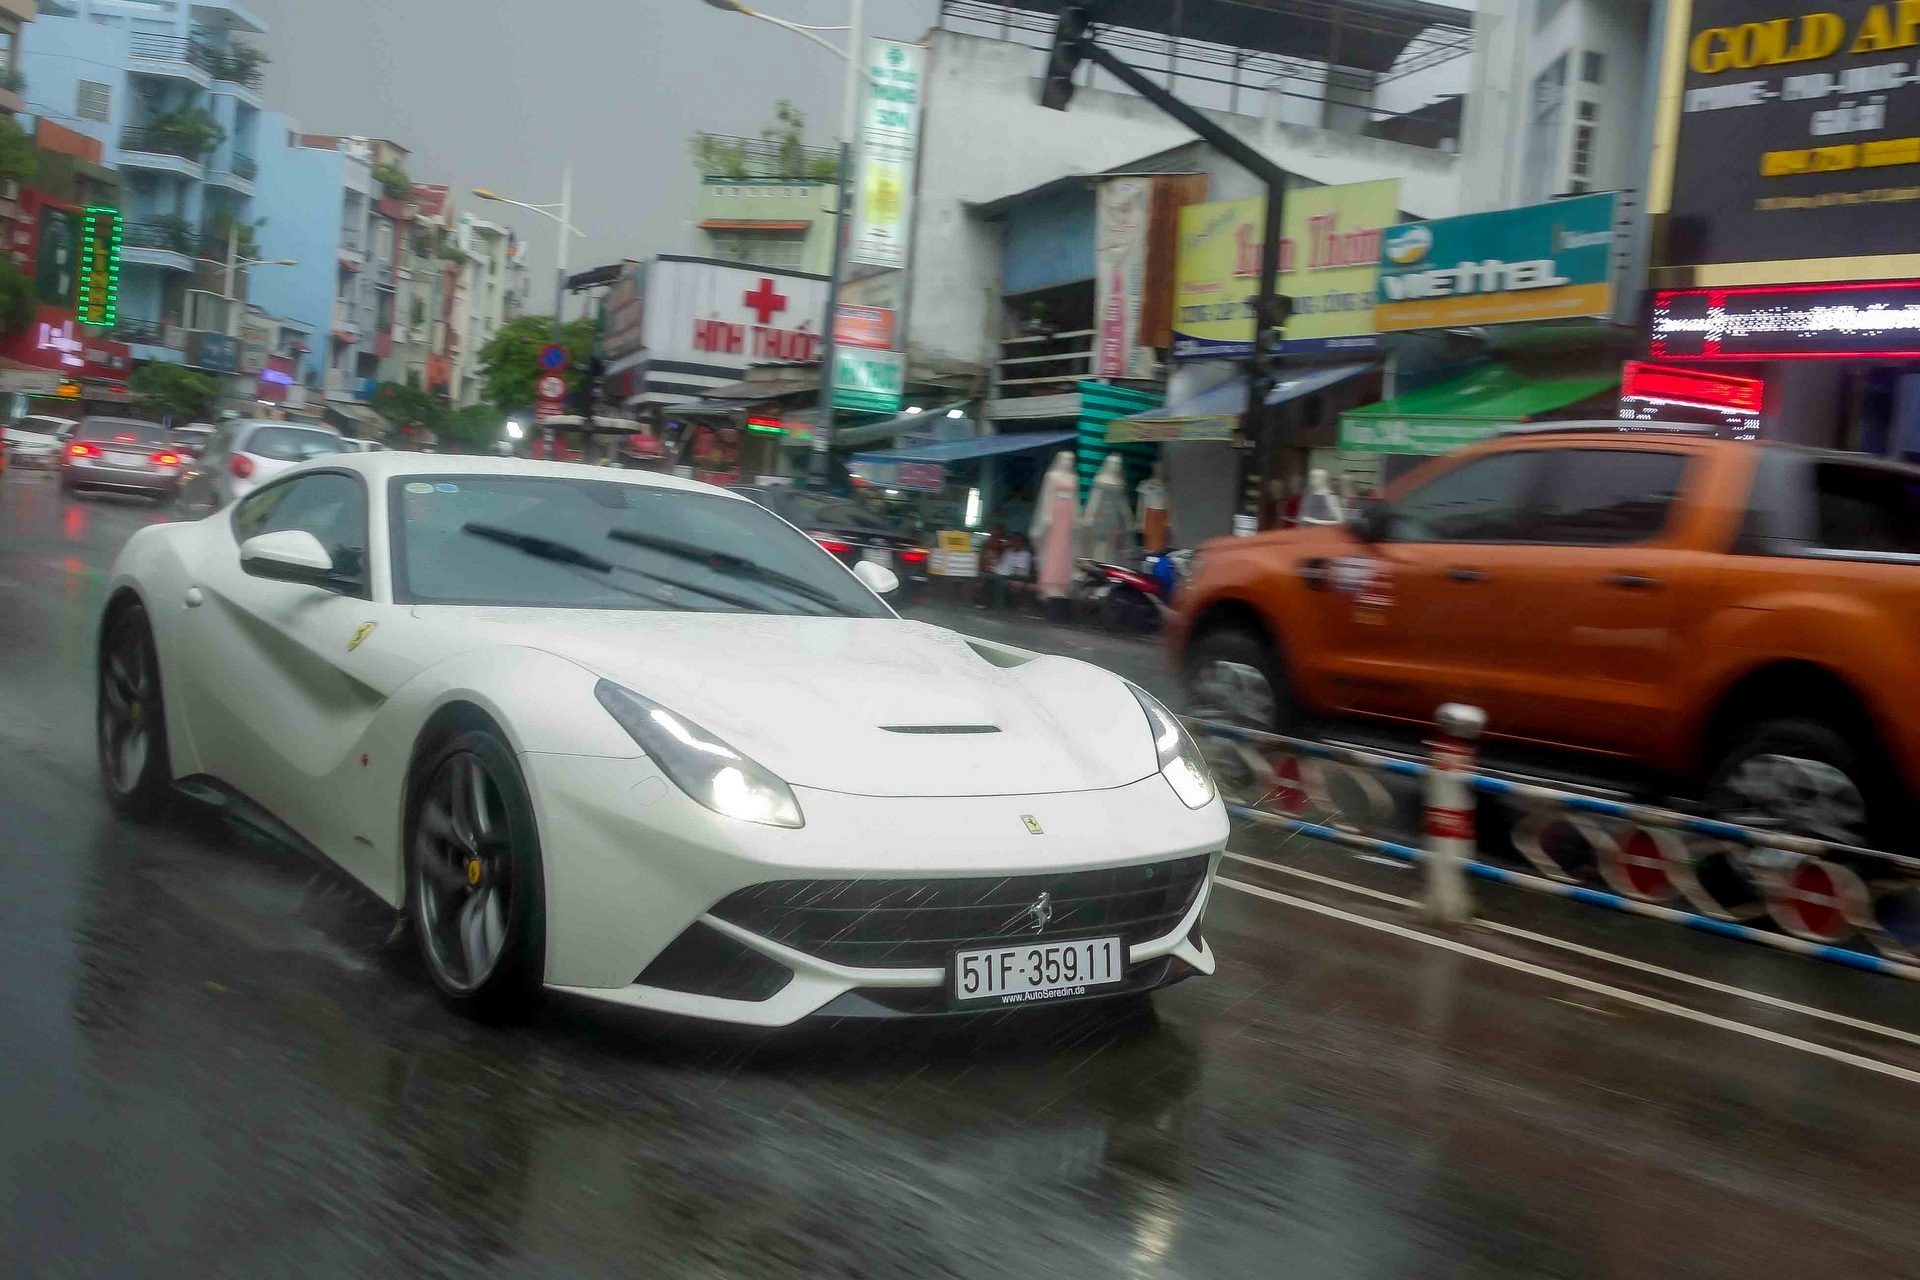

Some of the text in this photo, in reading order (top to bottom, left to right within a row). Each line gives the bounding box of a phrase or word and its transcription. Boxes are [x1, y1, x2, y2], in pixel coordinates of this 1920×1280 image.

[1690, 13, 1845, 73] GOLD
[963, 943, 1112, 993] 51F-359.11
[1001, 986, 1085, 1004] www.AutoSeredin.de
